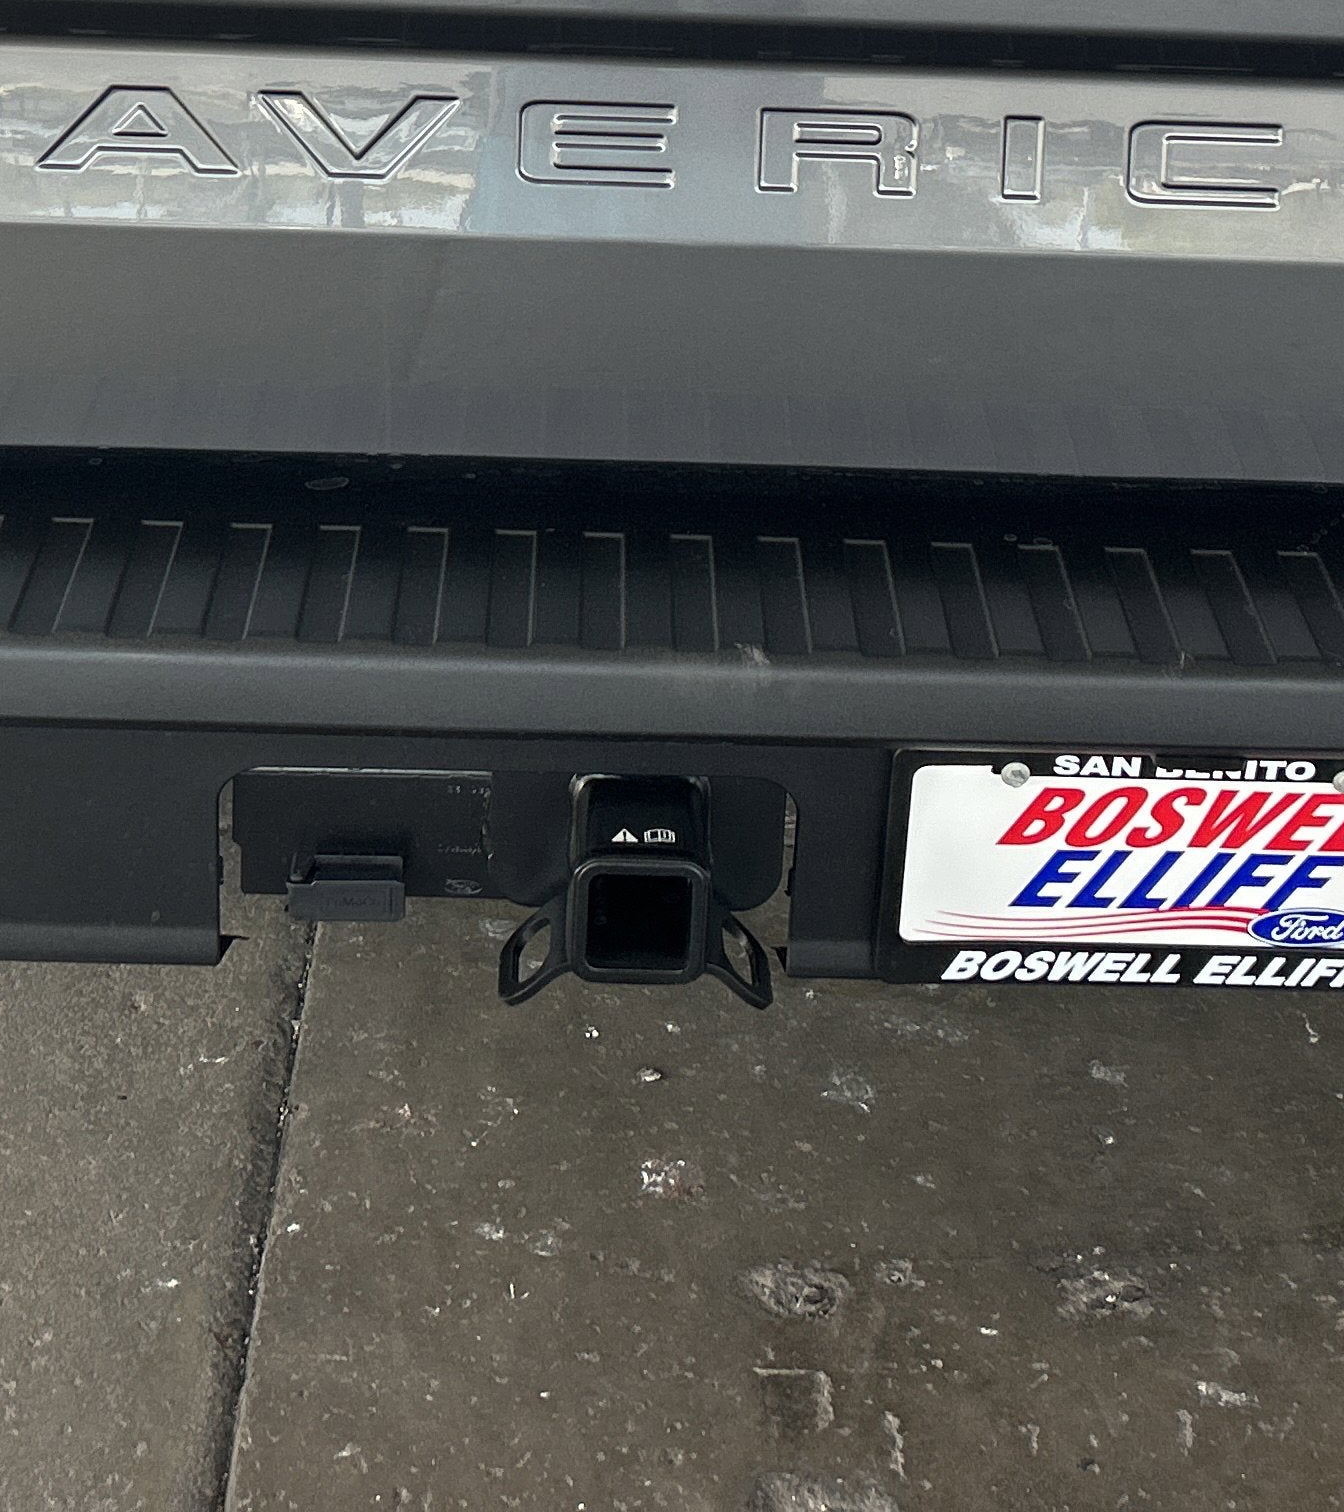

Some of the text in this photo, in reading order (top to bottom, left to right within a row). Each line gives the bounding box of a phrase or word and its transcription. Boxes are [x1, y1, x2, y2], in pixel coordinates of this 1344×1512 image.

[1053, 755, 1142, 778] SAN
[1270, 912, 1344, 942] Ford
[941, 950, 1181, 984] BOSWELL
